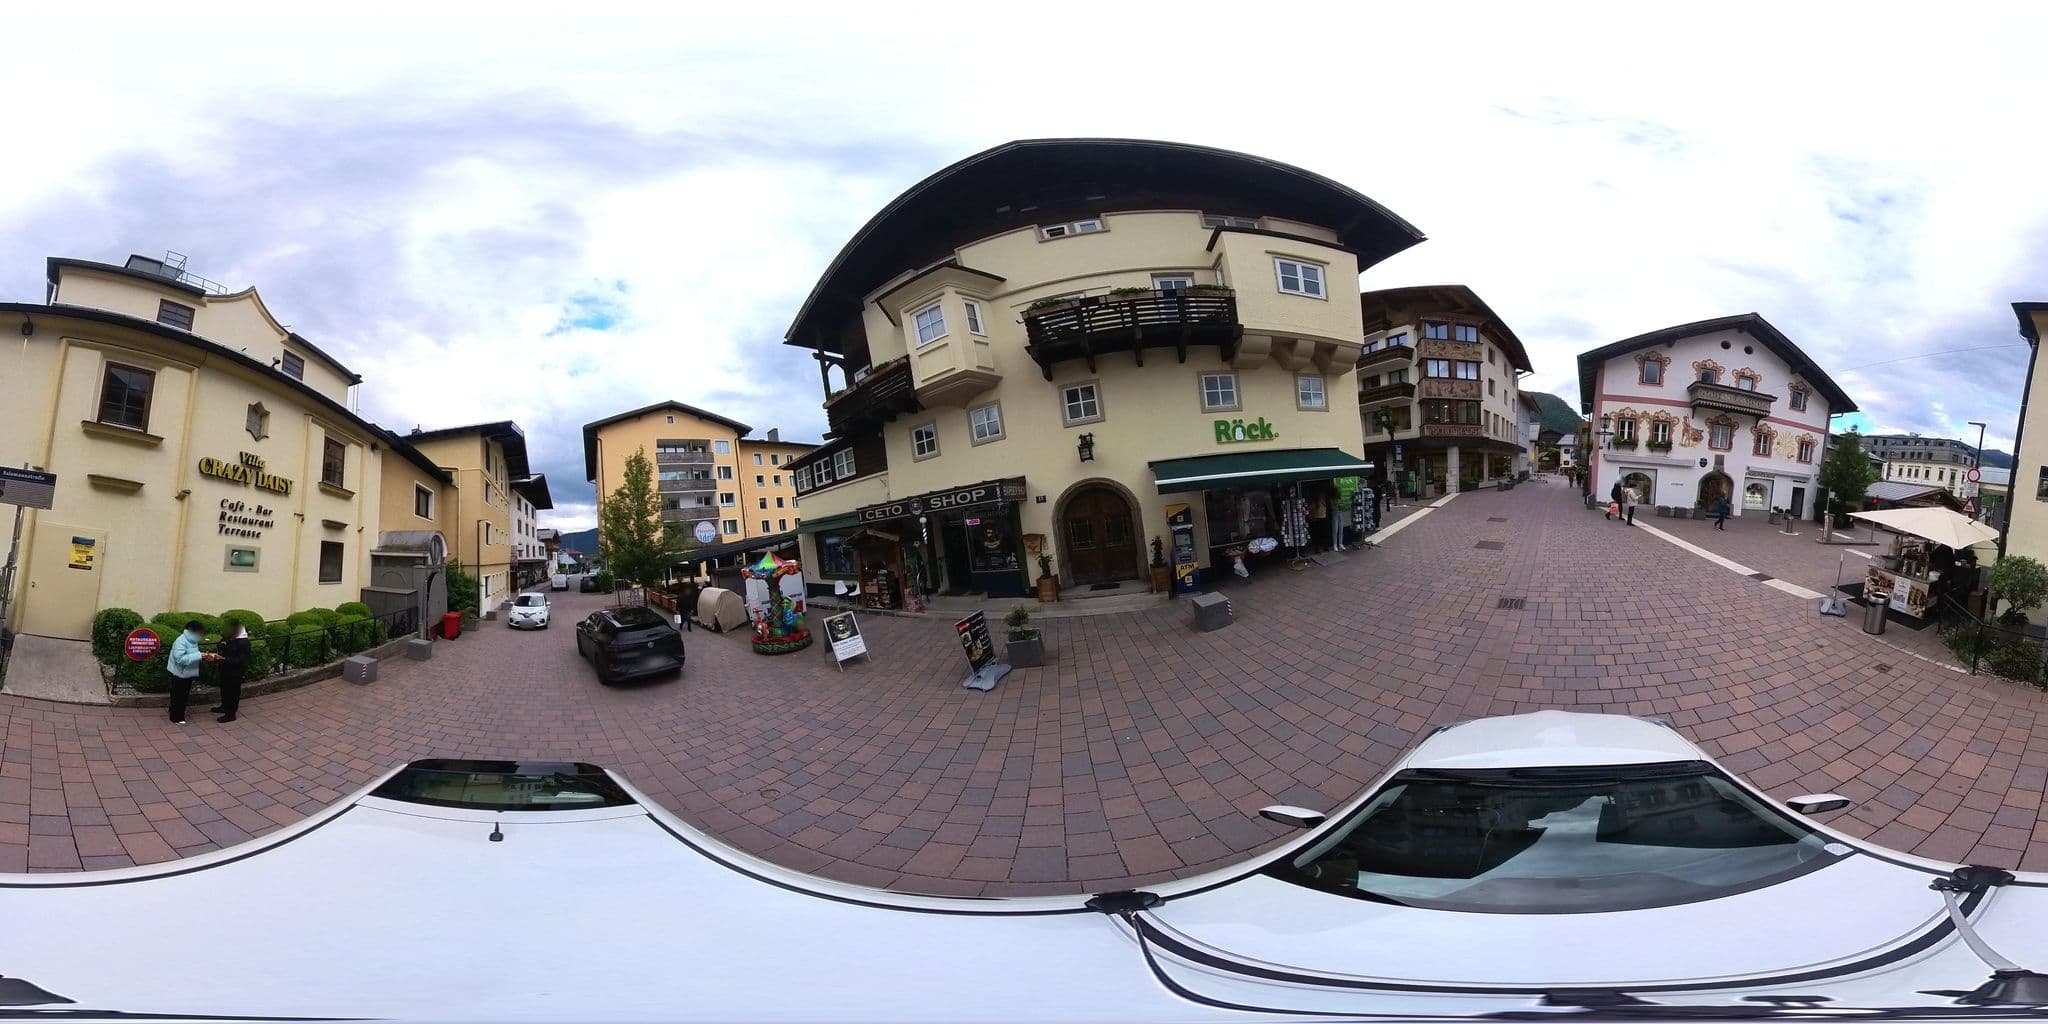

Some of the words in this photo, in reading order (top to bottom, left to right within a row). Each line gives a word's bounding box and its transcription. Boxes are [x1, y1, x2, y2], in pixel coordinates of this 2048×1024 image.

[239, 451, 266, 469] Villa
[199, 457, 253, 485] CRAZY
[255, 470, 293, 495] DAISY
[930, 489, 986, 509] SHOP
[256, 504, 273, 516] Bar
[865, 504, 903, 520] CETO
[219, 511, 274, 528] Restaurant
[218, 523, 262, 539] Terrasse
